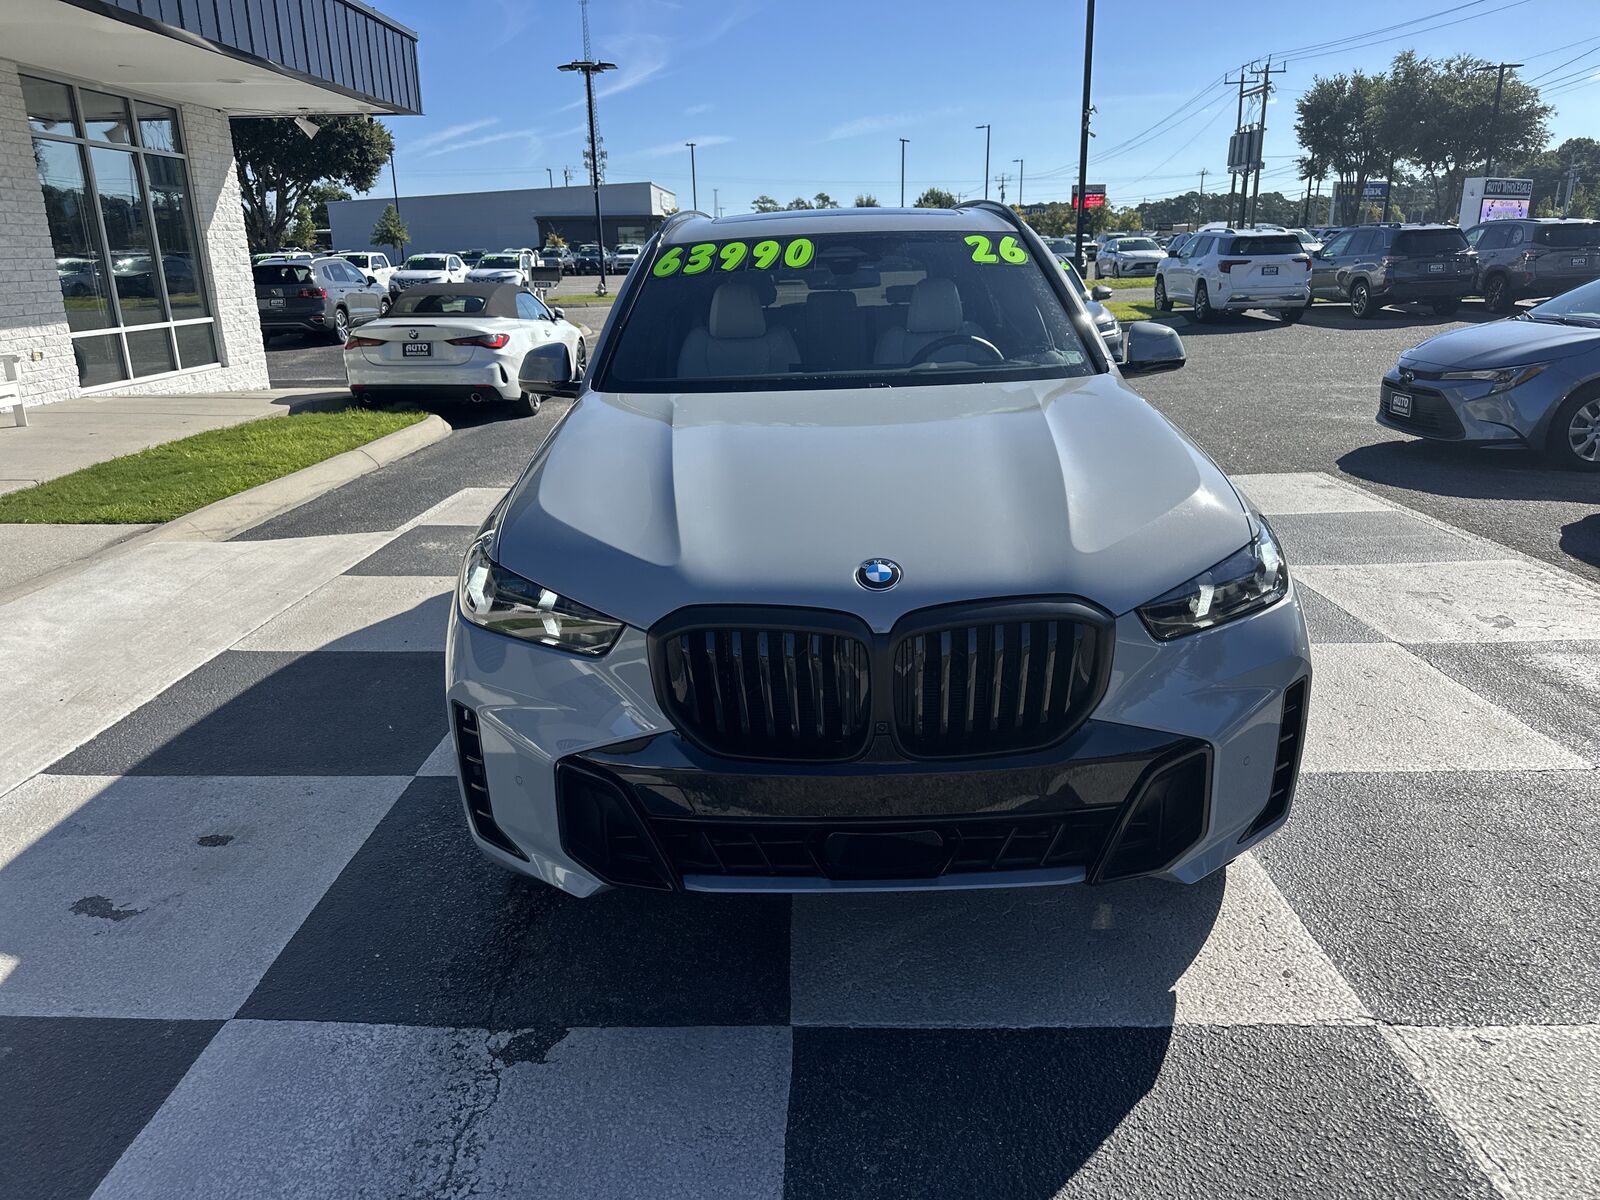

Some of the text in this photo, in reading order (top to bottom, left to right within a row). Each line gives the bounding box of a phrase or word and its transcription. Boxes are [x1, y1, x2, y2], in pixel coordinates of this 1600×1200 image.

[1486, 181, 1531, 194] AUTO WHOLESALE
[963, 234, 1029, 265] 26
[653, 238, 815, 277] 63990
[406, 344, 428, 352] AUTO
[1393, 395, 1409, 408] AUTO
